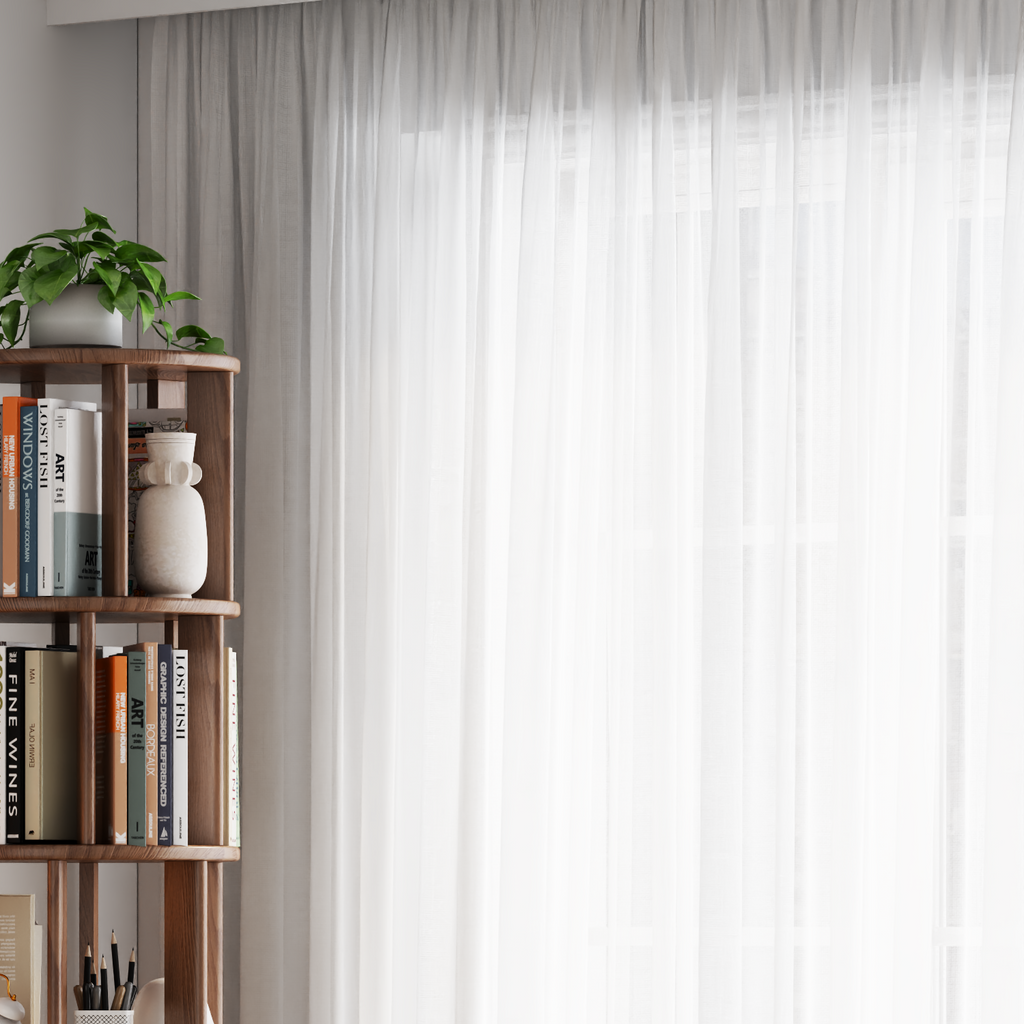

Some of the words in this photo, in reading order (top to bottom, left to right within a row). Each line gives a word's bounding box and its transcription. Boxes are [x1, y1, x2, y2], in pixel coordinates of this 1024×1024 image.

[40, 405, 48, 447] LOST
[22, 412, 33, 490] WINDOWS
[40, 452, 48, 488] FISH
[55, 453, 65, 483] ART
[84, 551, 98, 566] ART
[176, 656, 185, 699] LOST
[8, 674, 18, 727] FINE
[131, 697, 144, 728] ART
[176, 703, 185, 739] FISH
[146, 724, 156, 776] BORDEAUX
[8, 737, 18, 817] WINES
